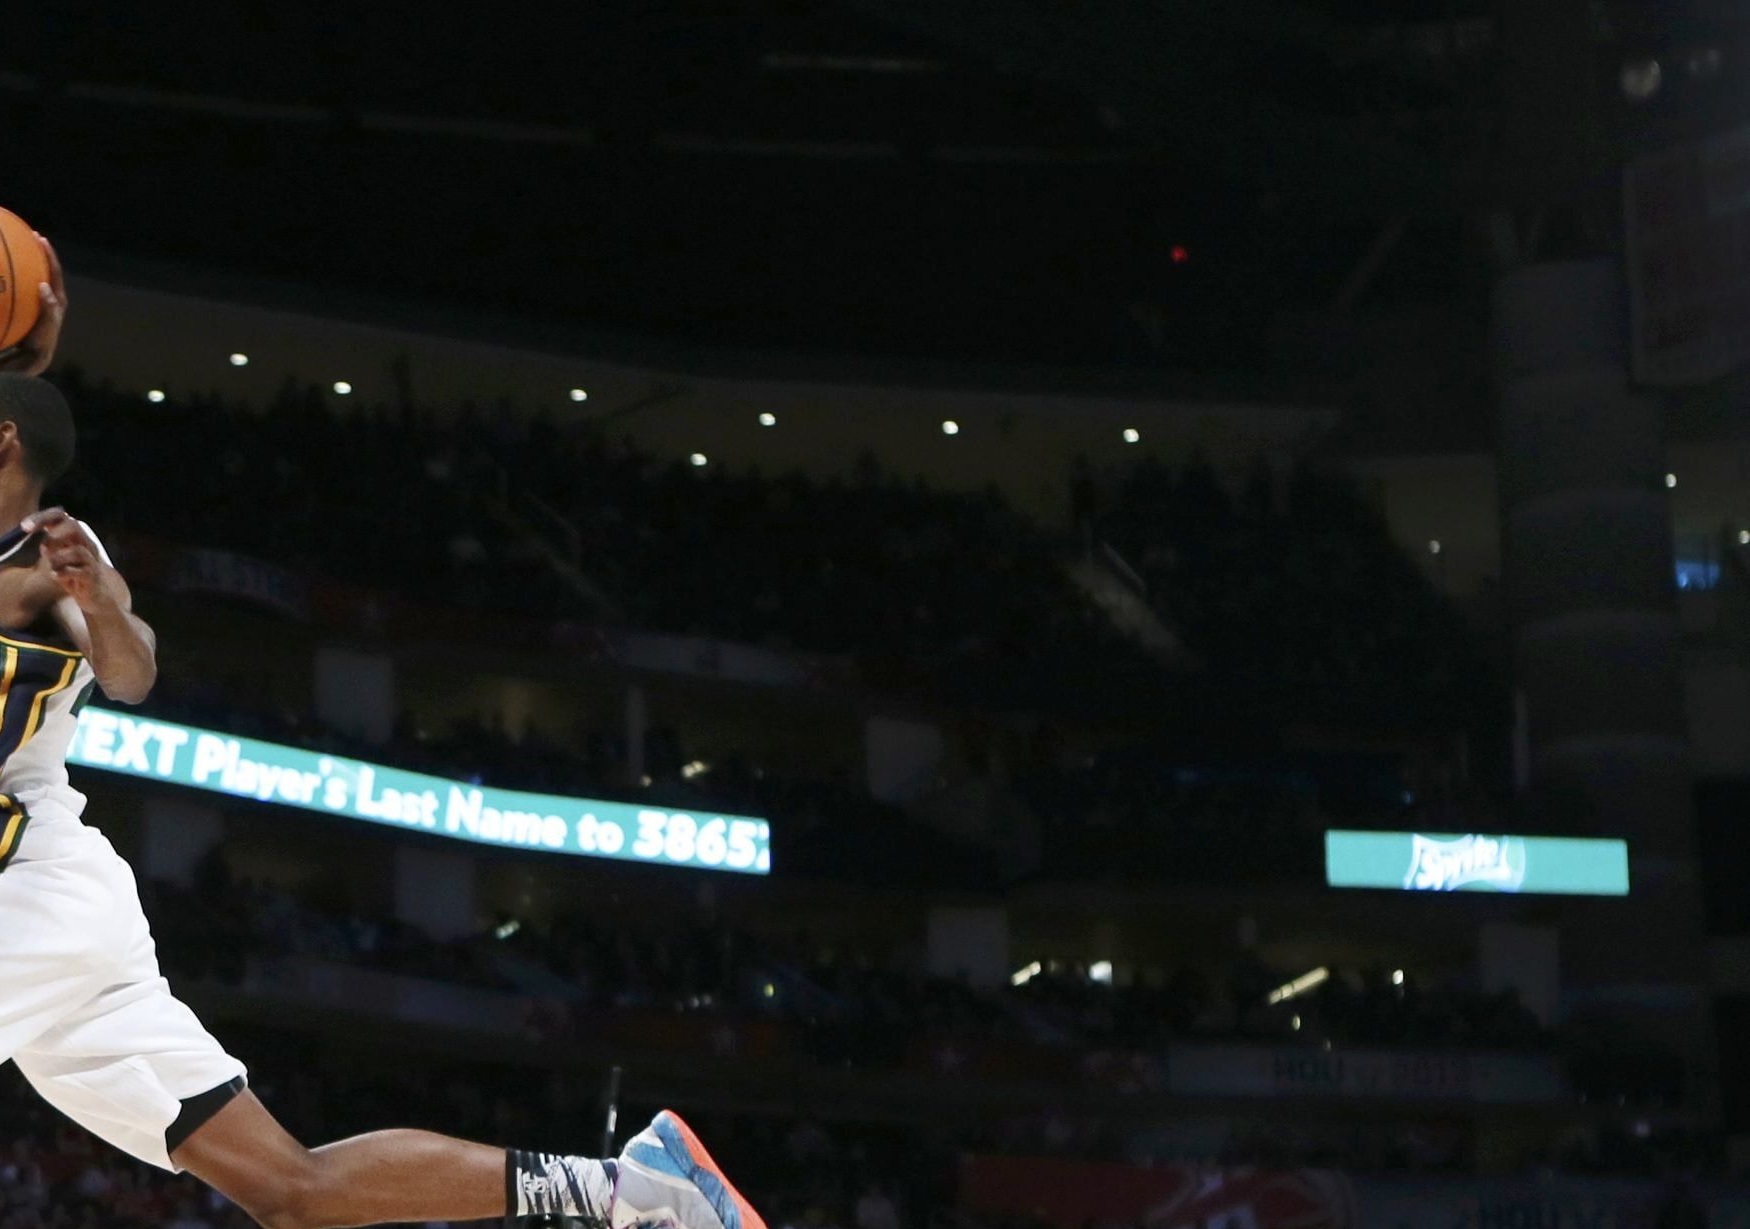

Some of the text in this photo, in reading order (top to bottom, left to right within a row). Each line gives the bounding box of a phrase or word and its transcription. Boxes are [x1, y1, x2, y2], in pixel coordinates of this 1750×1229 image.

[79, 708, 188, 776] EXT
[191, 734, 348, 810] Player's
[355, 764, 440, 828] Last
[444, 785, 568, 849] Name
[576, 813, 625, 854] to
